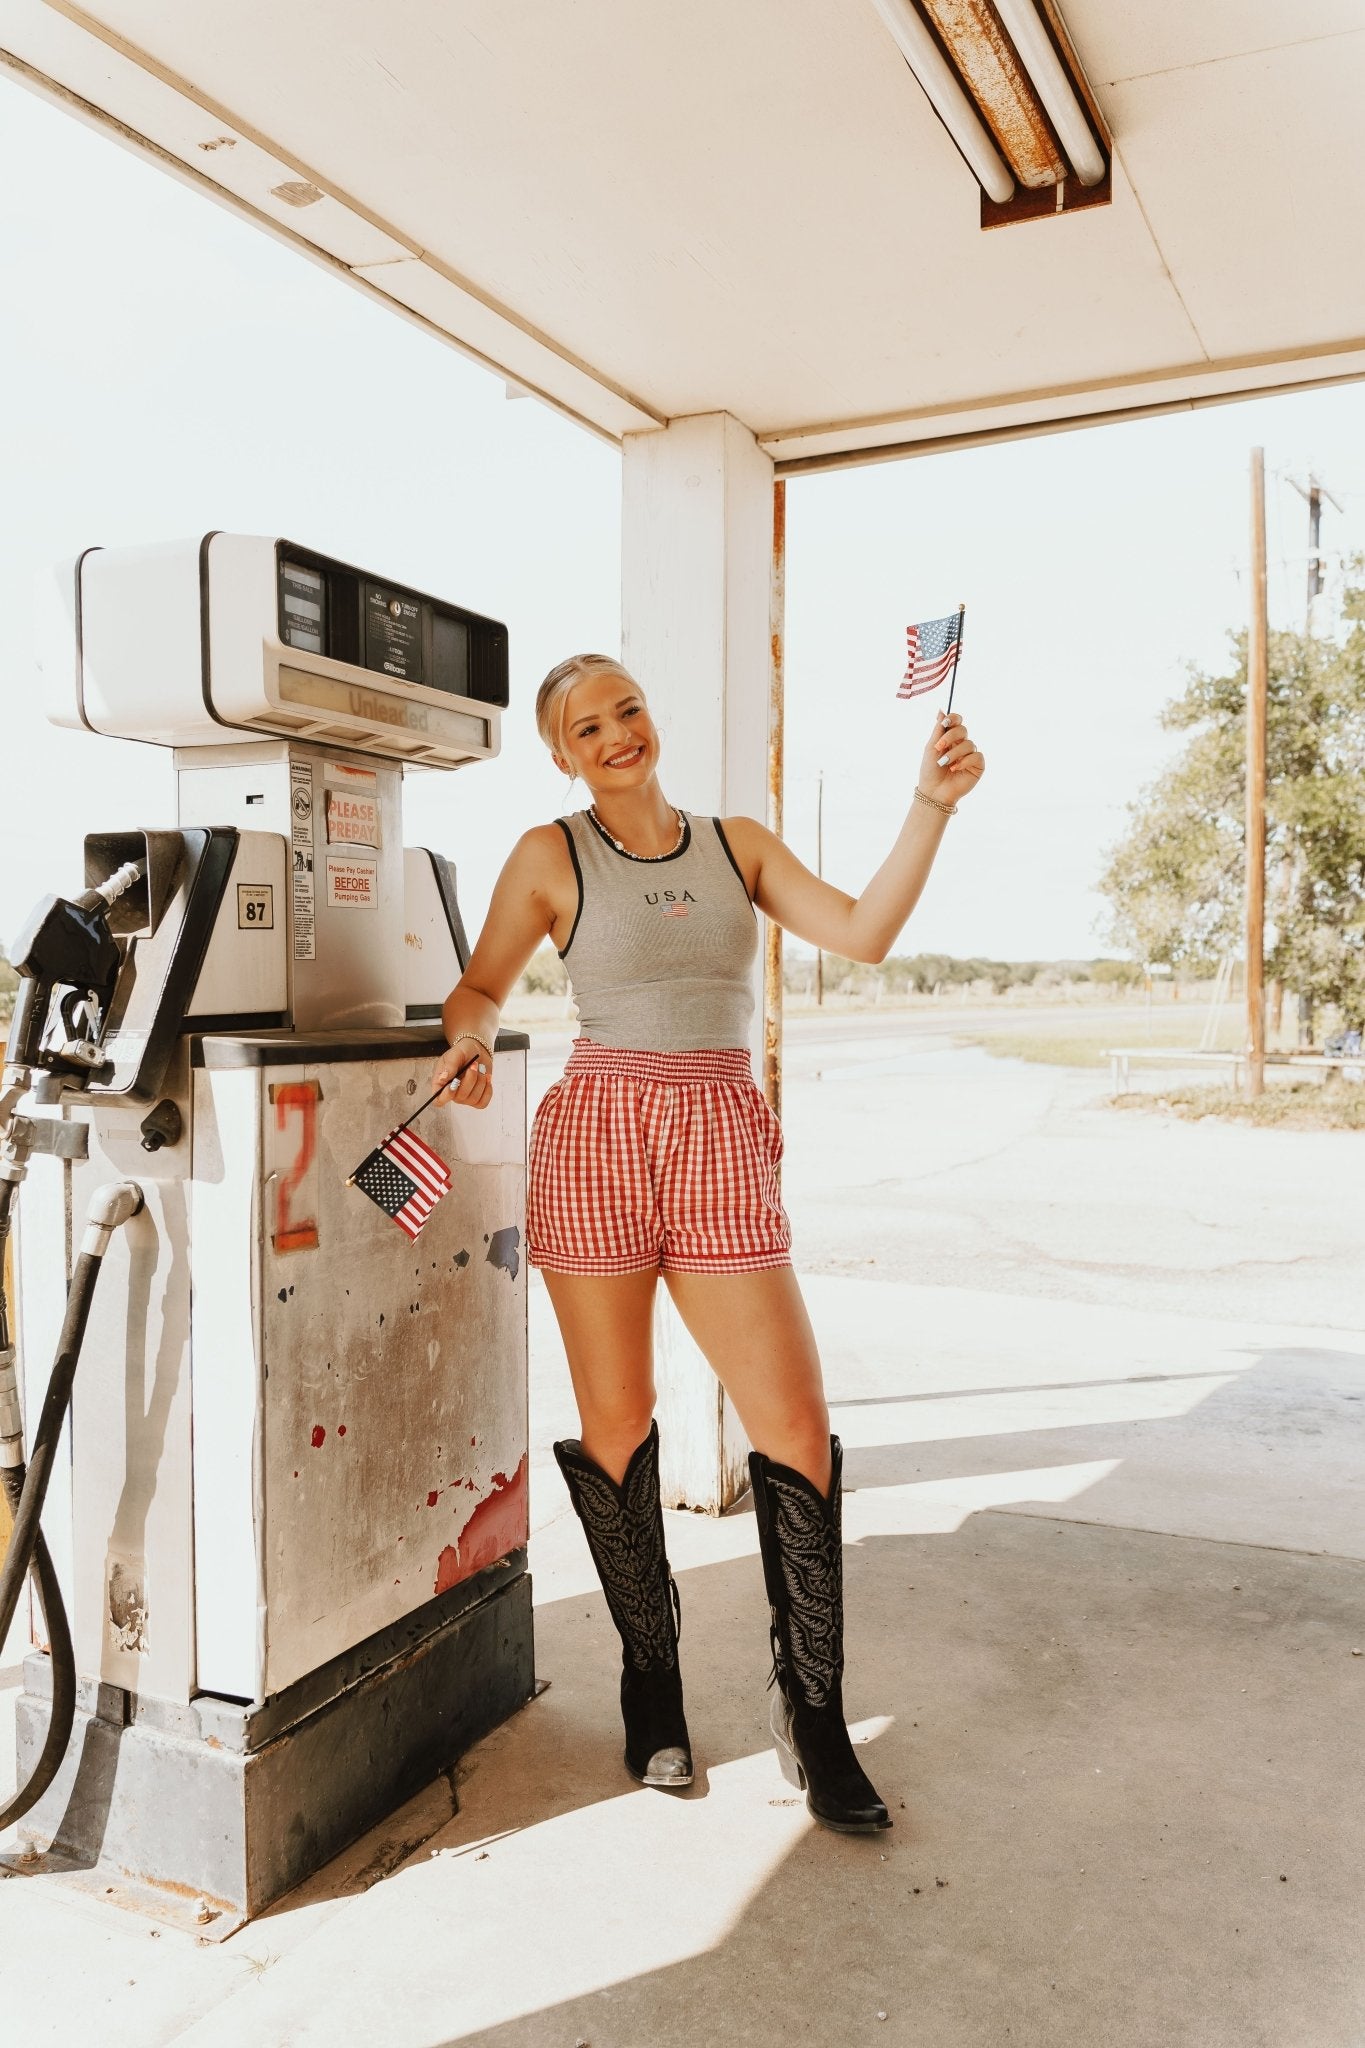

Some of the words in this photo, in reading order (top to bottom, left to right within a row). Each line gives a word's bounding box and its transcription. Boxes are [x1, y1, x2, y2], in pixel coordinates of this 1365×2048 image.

[349, 691, 429, 733] Unleaded
[328, 799, 374, 822] PLEASE
[329, 819, 376, 842] PREPAY
[328, 864, 345, 873] Please
[346, 866, 356, 876] Pay
[356, 867, 375, 875] Cashier
[334, 876, 371, 890] BEFORE
[334, 892, 359, 903] Pumping
[359, 893, 371, 902] Gas
[644, 889, 698, 905] USA
[246, 901, 266, 922] 87
